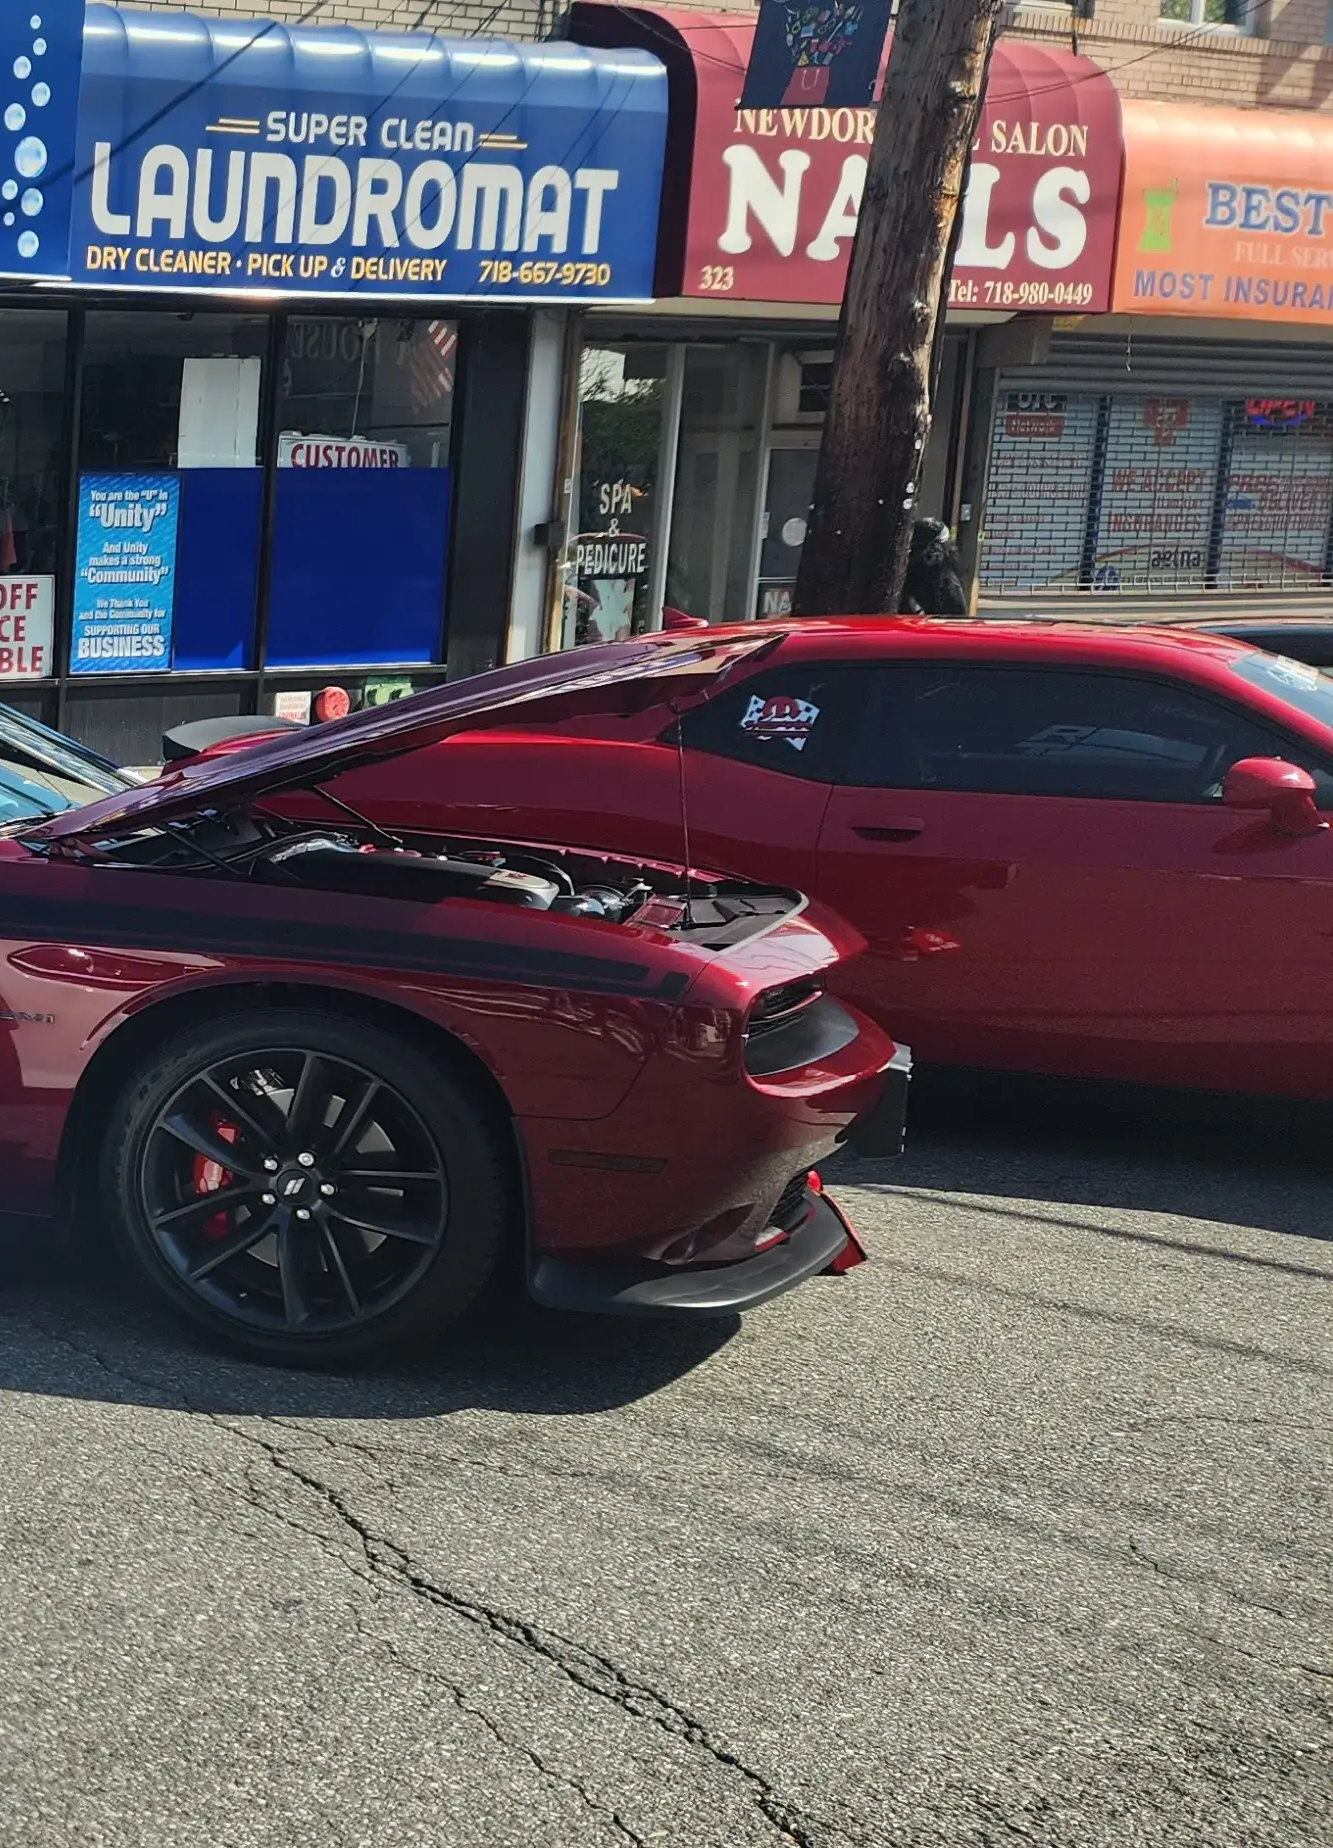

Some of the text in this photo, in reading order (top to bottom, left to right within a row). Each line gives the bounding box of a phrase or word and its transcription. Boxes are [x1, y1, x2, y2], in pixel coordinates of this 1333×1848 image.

[265, 111, 475, 152] SUPER CLEAN
[734, 108, 876, 145] NEWDOR
[991, 120, 1089, 157] SALON
[91, 141, 620, 255] LAUNDROMAT
[717, 143, 1091, 271] NALS
[86, 246, 612, 287] DRY CLEANER PICK UP & DELIVERY 718-667-9730
[698, 265, 734, 291] 323
[948, 279, 1093, 306] Tel: 718-980-0449
[1134, 270, 1333, 310] MOST INSURA
[290, 443, 400, 468] CUSTOMER
[90, 490, 107, 503] You
[108, 491, 123, 502] are
[124, 489, 140, 502] the
[159, 489, 169, 501] in
[599, 483, 633, 516] SPA
[607, 517, 623, 539] &
[89, 555, 120, 566] makes
[129, 554, 162, 568] strong
[102, 540, 149, 555] And Unity
[576, 542, 648, 575] PEDICURE
[84, 623, 160, 637] SUPPORTING OUR
[77, 634, 165, 659] BUSINESS
